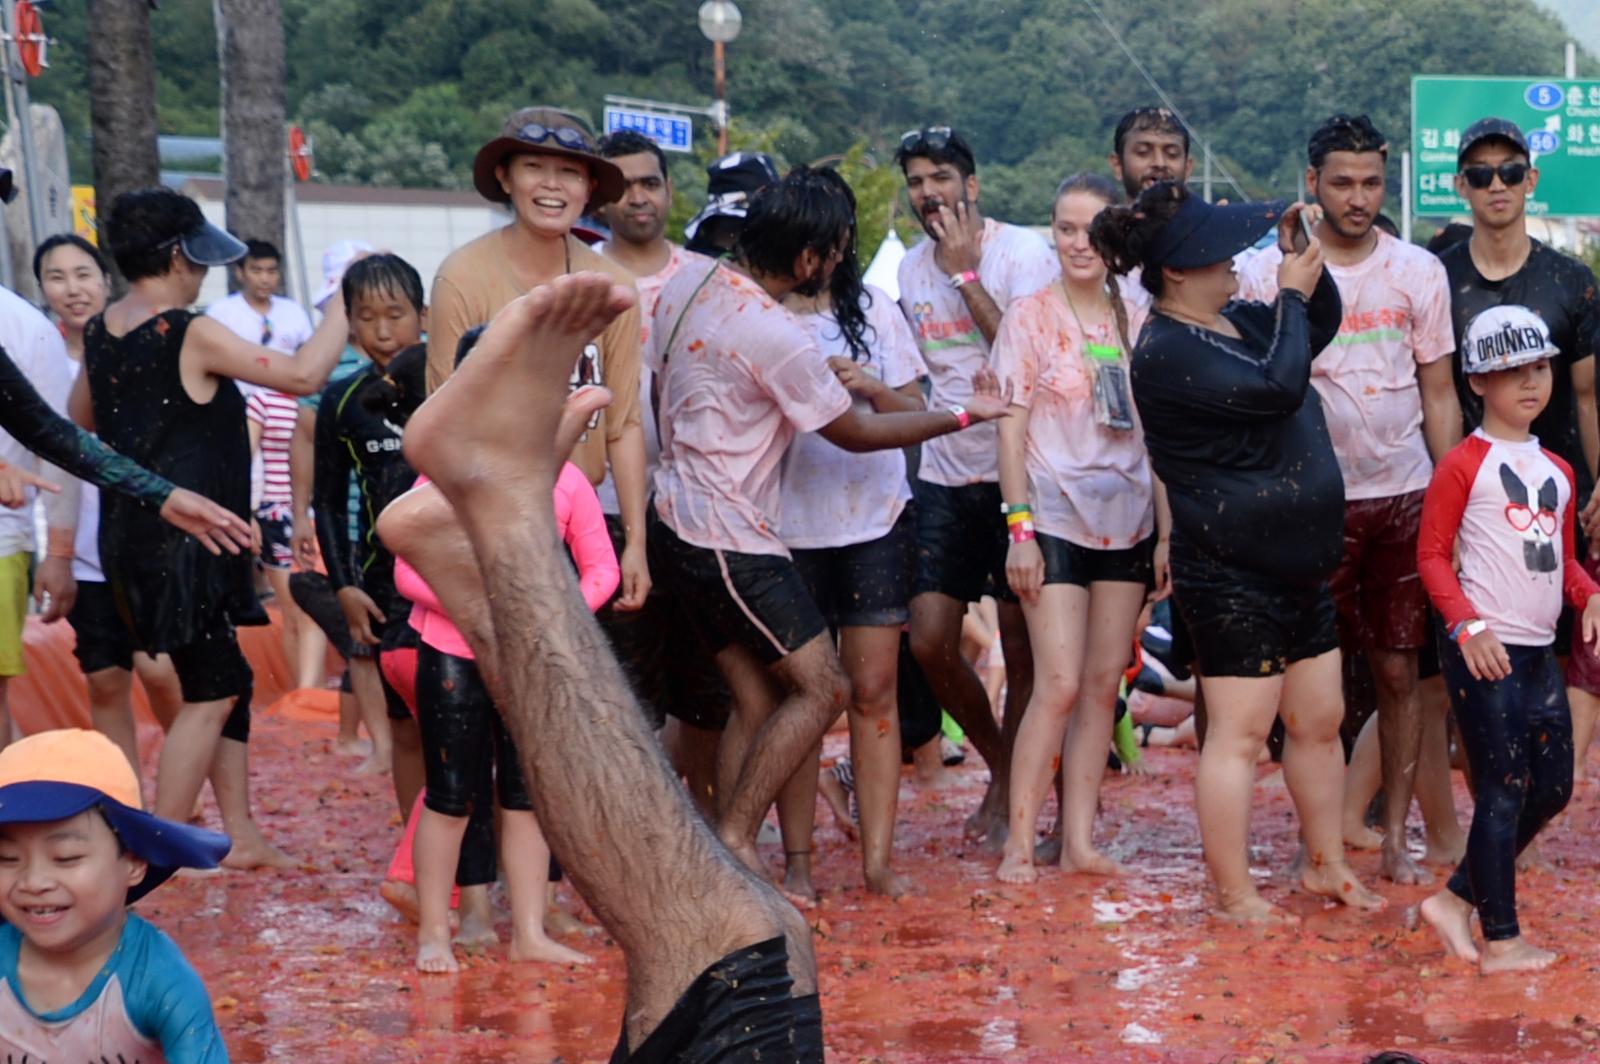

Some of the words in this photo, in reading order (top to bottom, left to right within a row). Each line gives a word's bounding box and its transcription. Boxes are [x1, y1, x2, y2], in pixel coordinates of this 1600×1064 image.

[1537, 88, 1552, 105] 5
[1530, 134, 1552, 151] 56
[1477, 327, 1545, 361] DRUNKEN
